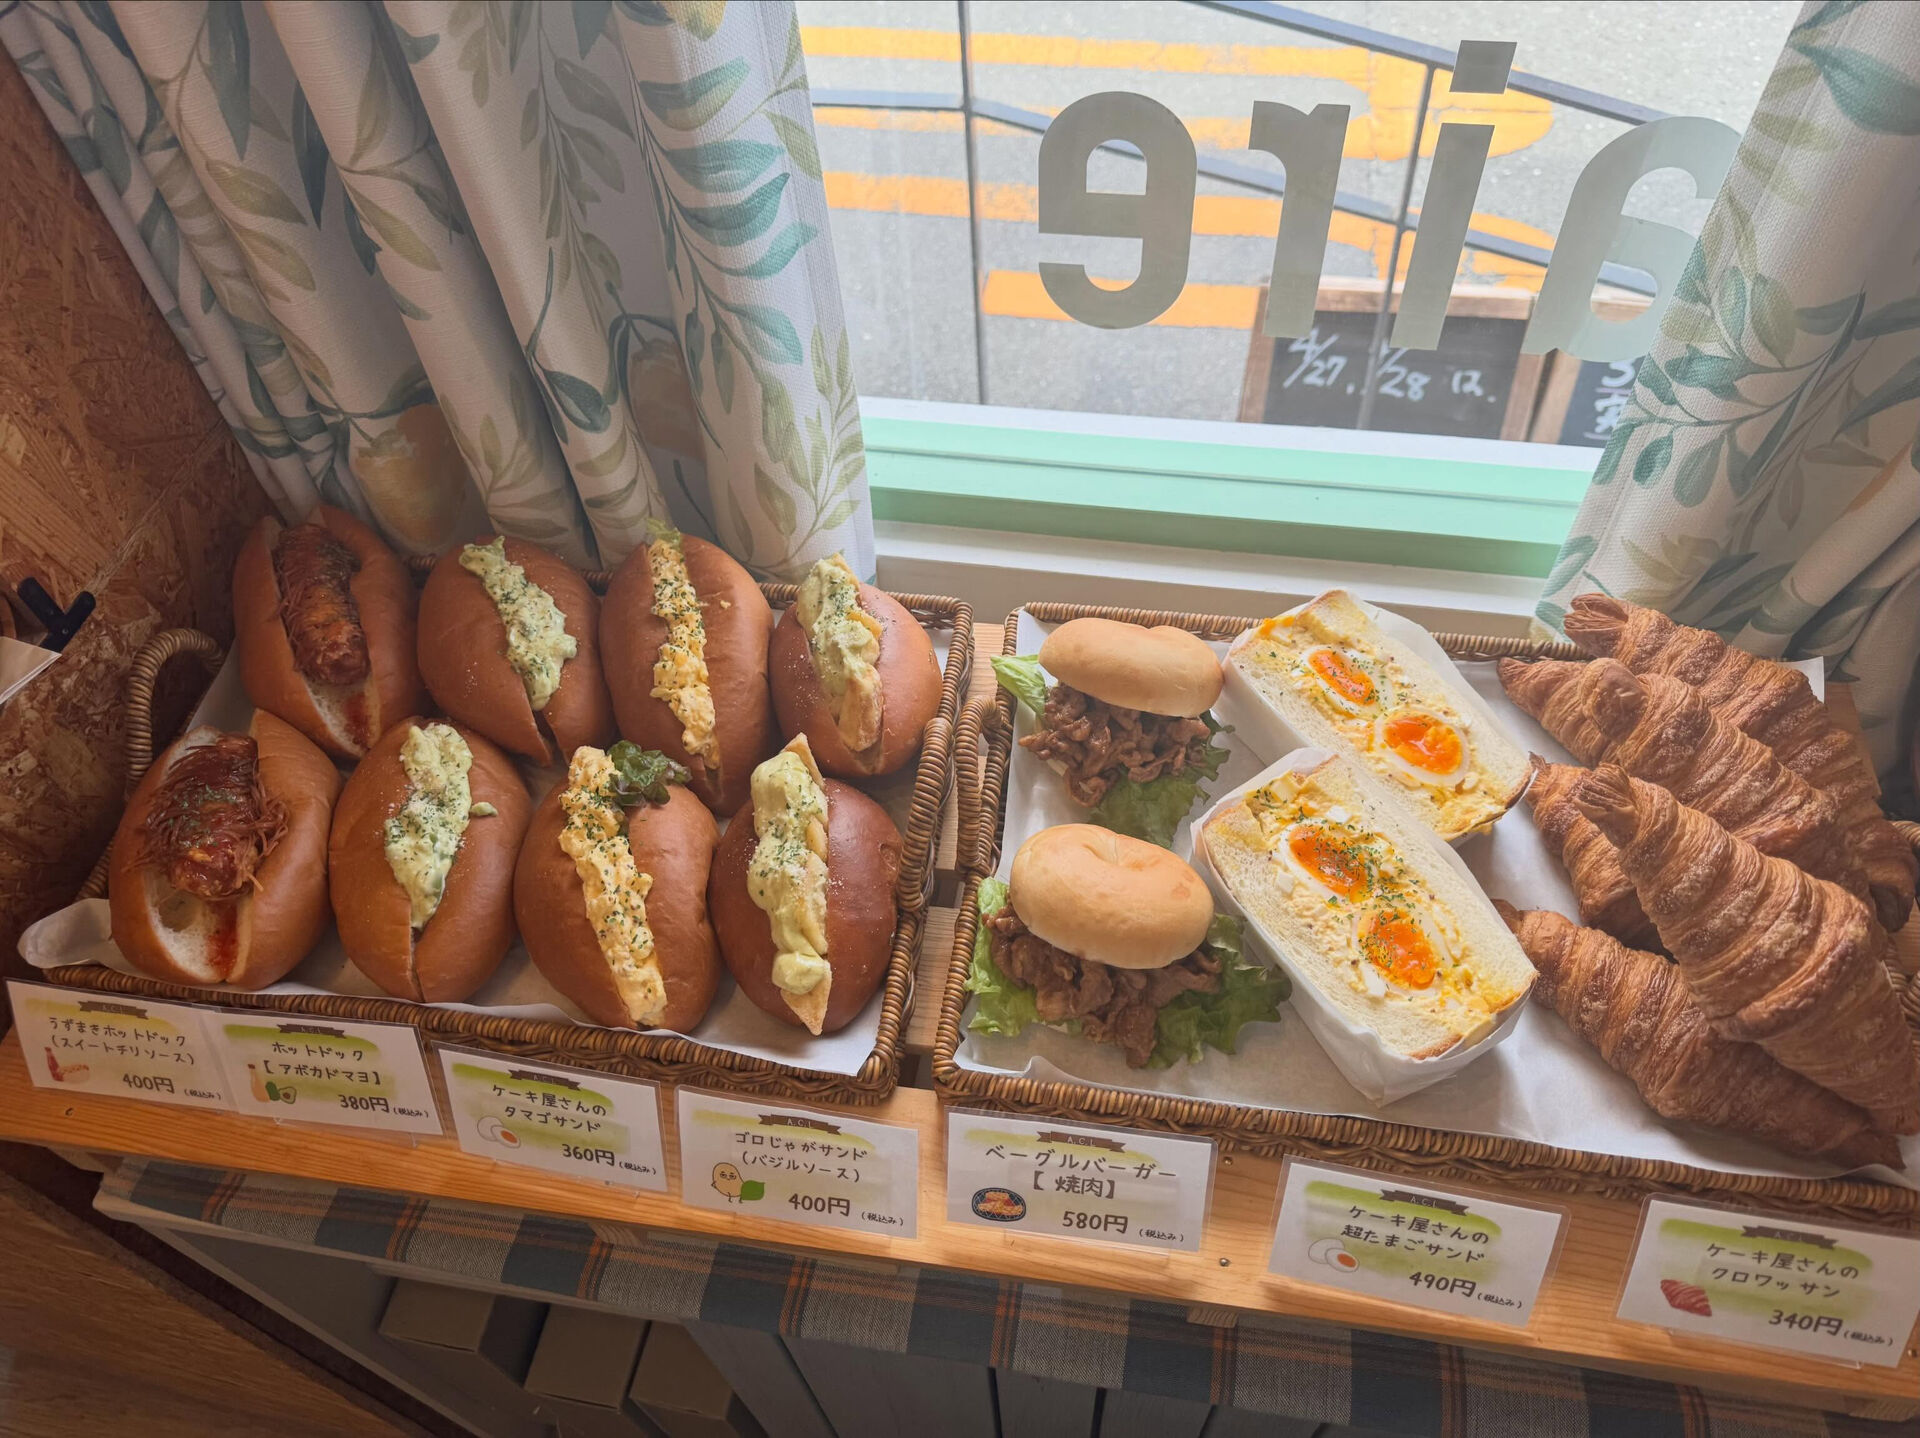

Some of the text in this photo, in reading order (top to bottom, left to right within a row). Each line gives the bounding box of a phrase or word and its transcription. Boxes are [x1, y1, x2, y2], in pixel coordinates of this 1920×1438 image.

[272, 1041, 363, 1061] ホットドック
[123, 1073, 175, 1094] 400円
[338, 1094, 389, 1113] 380円
[492, 1084, 607, 1117] ケーキ屋さんの
[505, 1106, 601, 1133] タマゴサンド
[562, 1143, 615, 1167] 360円
[735, 1131, 868, 1161] ゴロじゃがサンド
[742, 1151, 860, 1182] （バジルソース）
[985, 1145, 1177, 1180] ベーグルバーガー
[788, 1193, 850, 1217] 400円
[1062, 1210, 1129, 1234] 580円
[1349, 1205, 1489, 1245] ケーキ屋さんの
[1340, 1223, 1485, 1264] 超たまごサンド
[1706, 1243, 1859, 1280] ケーキ屋さんの
[1409, 1271, 1477, 1298] 490円
[1711, 1267, 1841, 1299] クロワッサン
[1768, 1309, 1843, 1337] 340円
